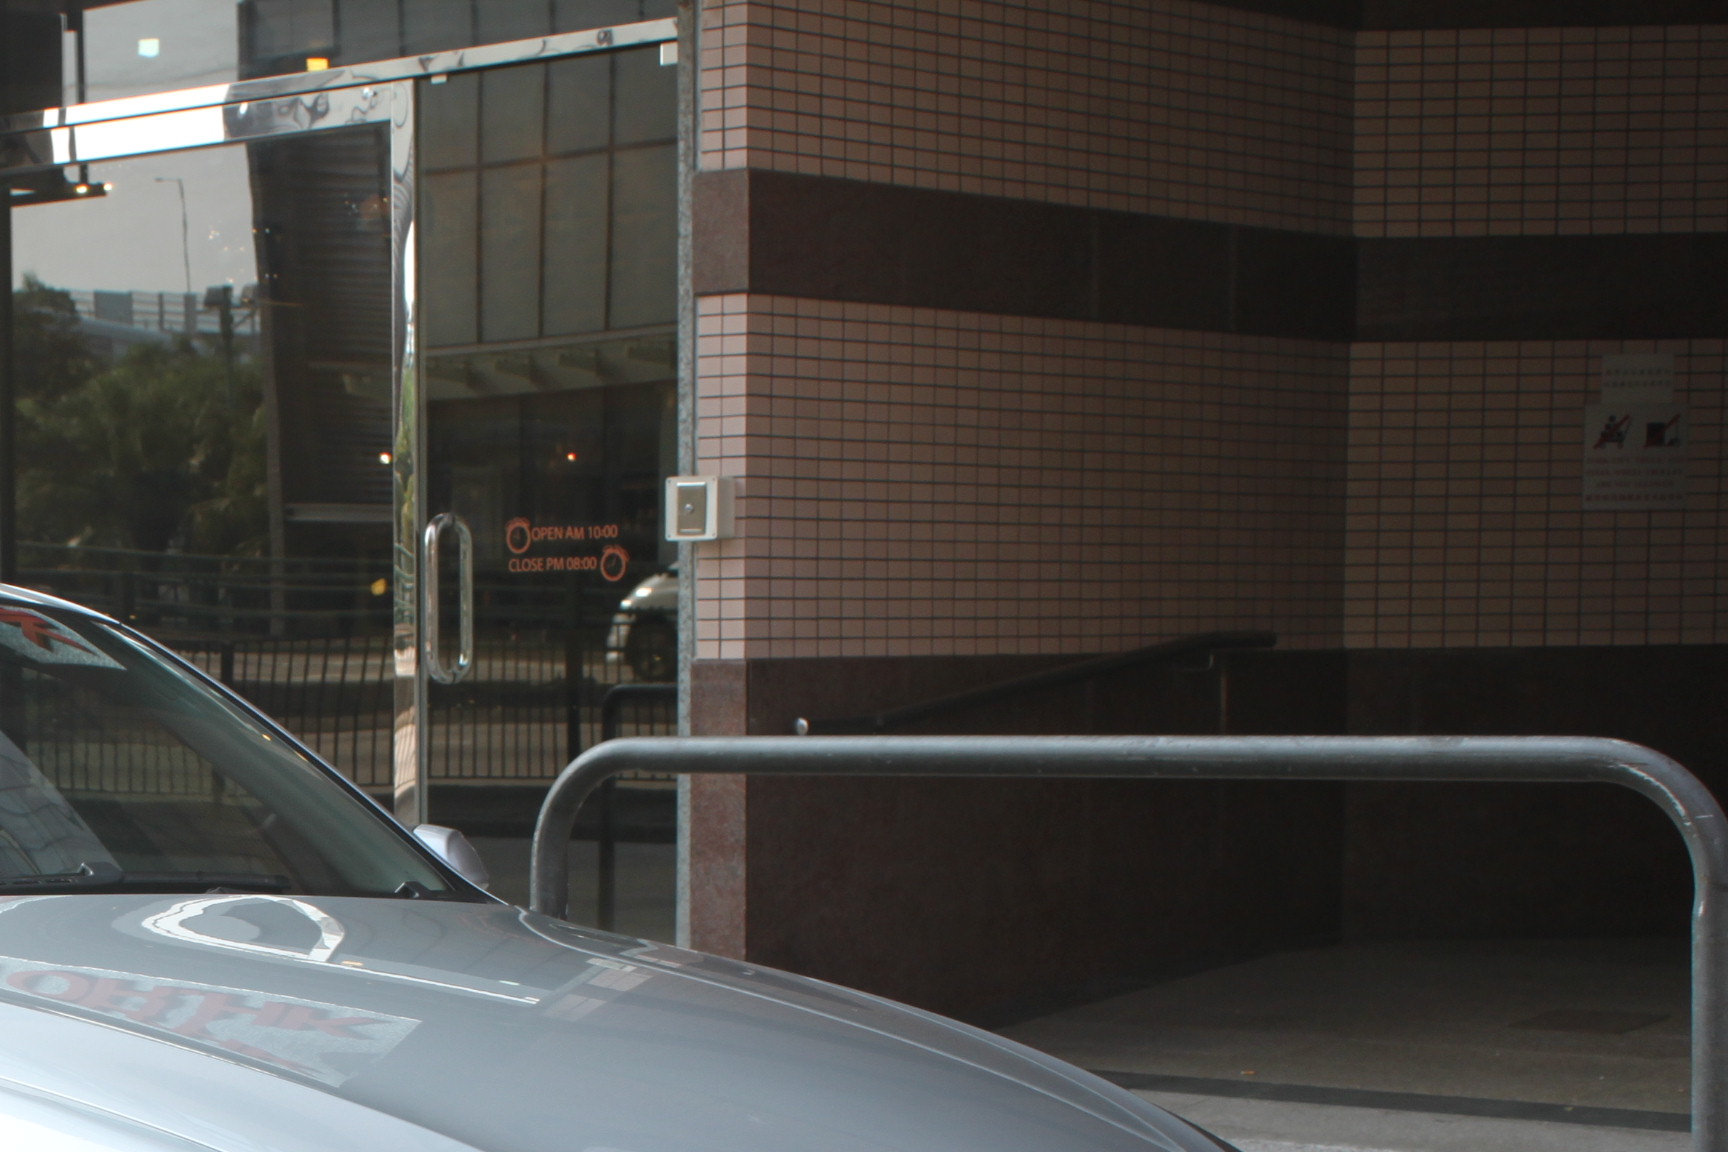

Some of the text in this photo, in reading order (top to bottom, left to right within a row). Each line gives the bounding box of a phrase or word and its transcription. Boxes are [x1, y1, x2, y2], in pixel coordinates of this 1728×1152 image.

[531, 524, 618, 541] OPEN AM 10:00
[508, 556, 597, 572] CLOSE PM 08:00
